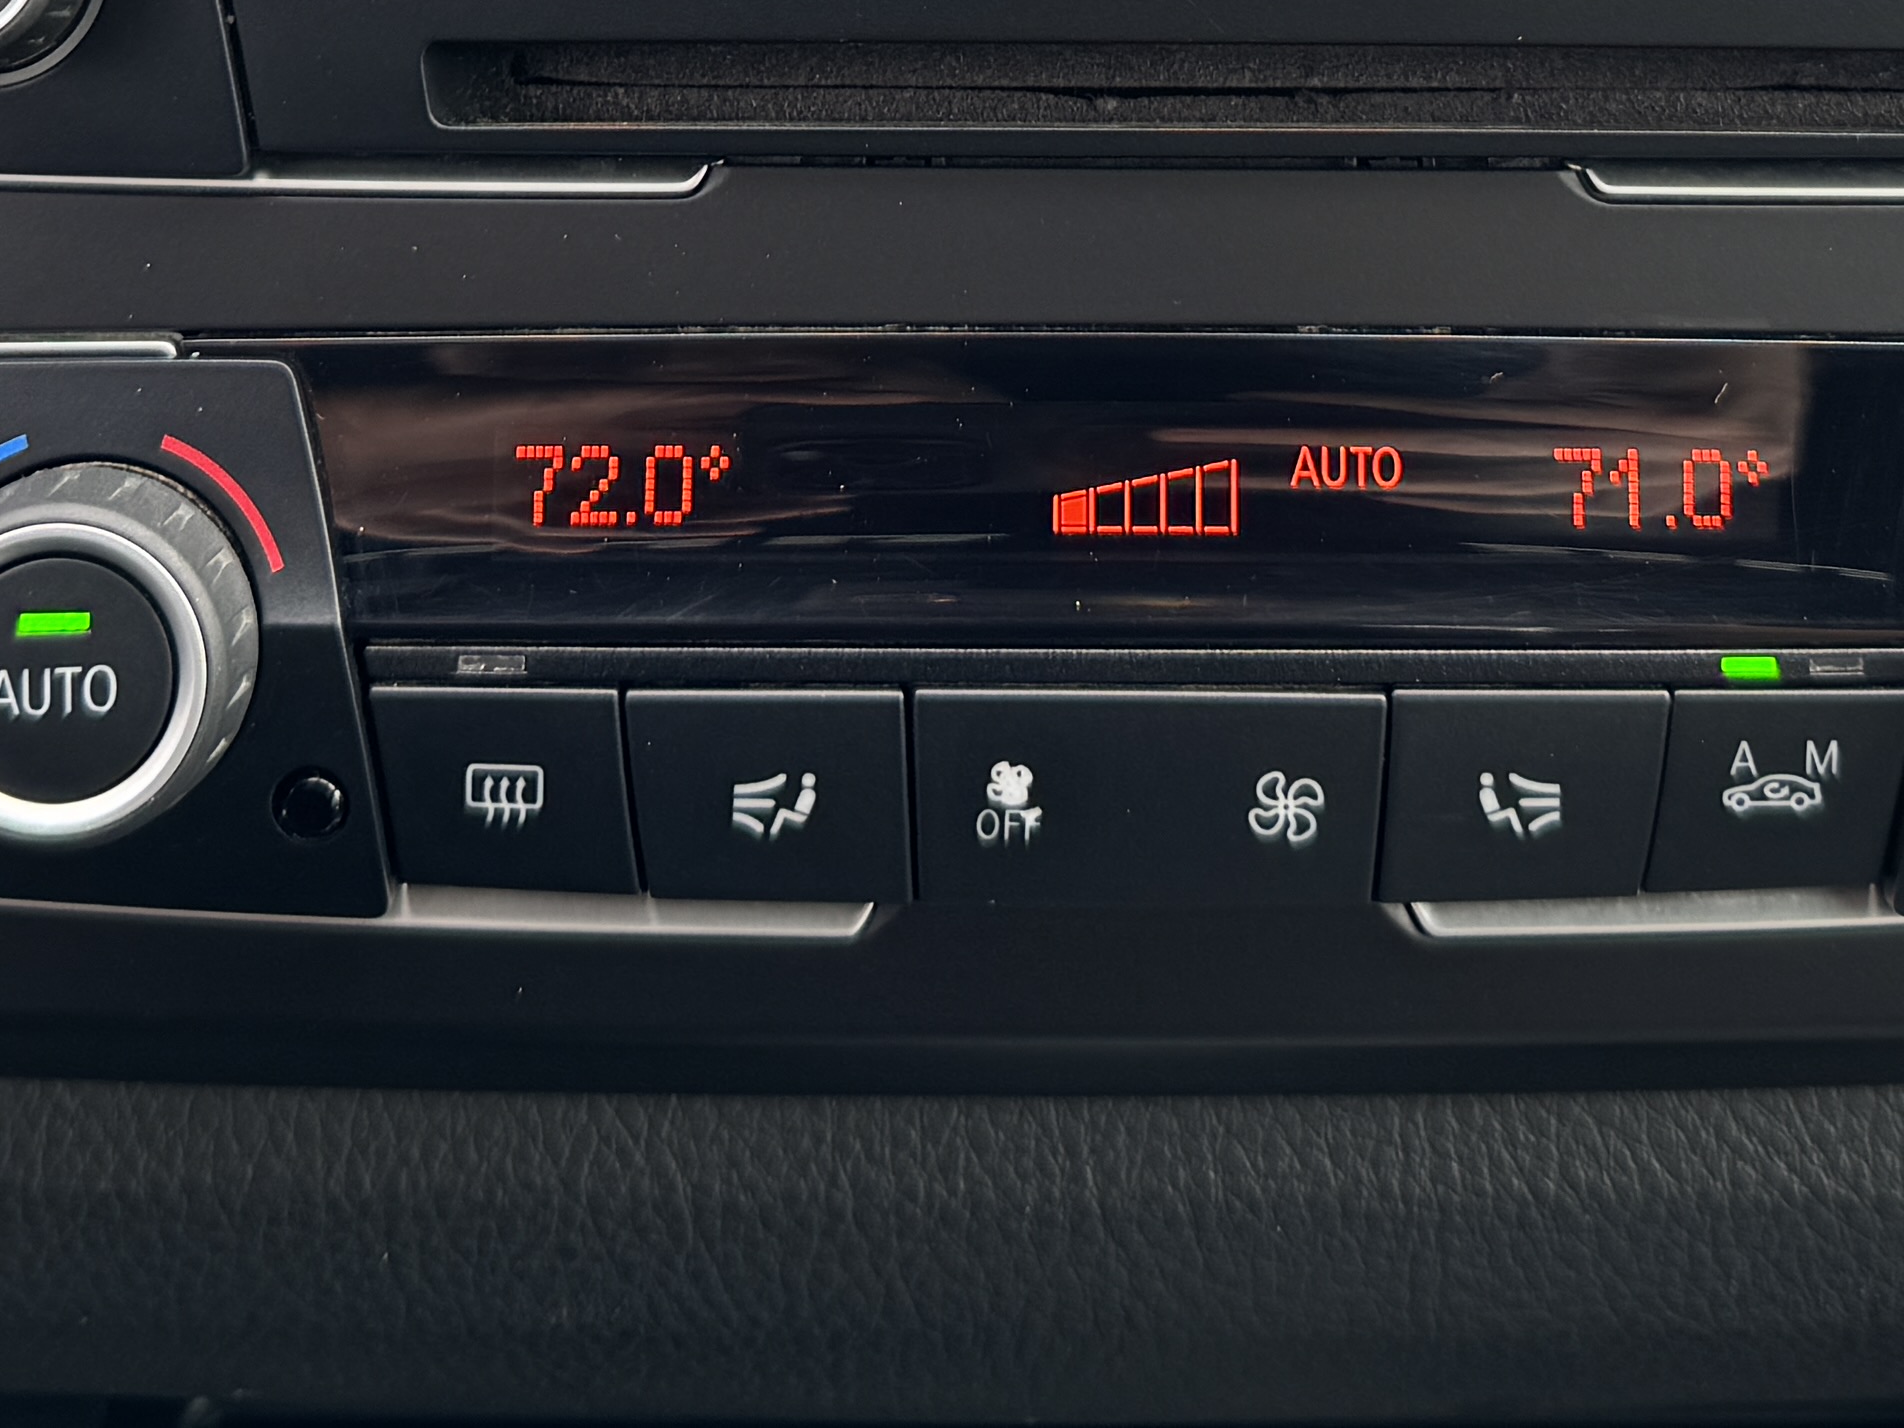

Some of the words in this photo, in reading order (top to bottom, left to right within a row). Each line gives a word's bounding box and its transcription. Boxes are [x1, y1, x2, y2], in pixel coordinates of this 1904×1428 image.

[1290, 444, 1404, 490] AUTO
[1730, 739, 1759, 777] A
[1804, 739, 1840, 778] M
[975, 805, 1043, 846] OFF
